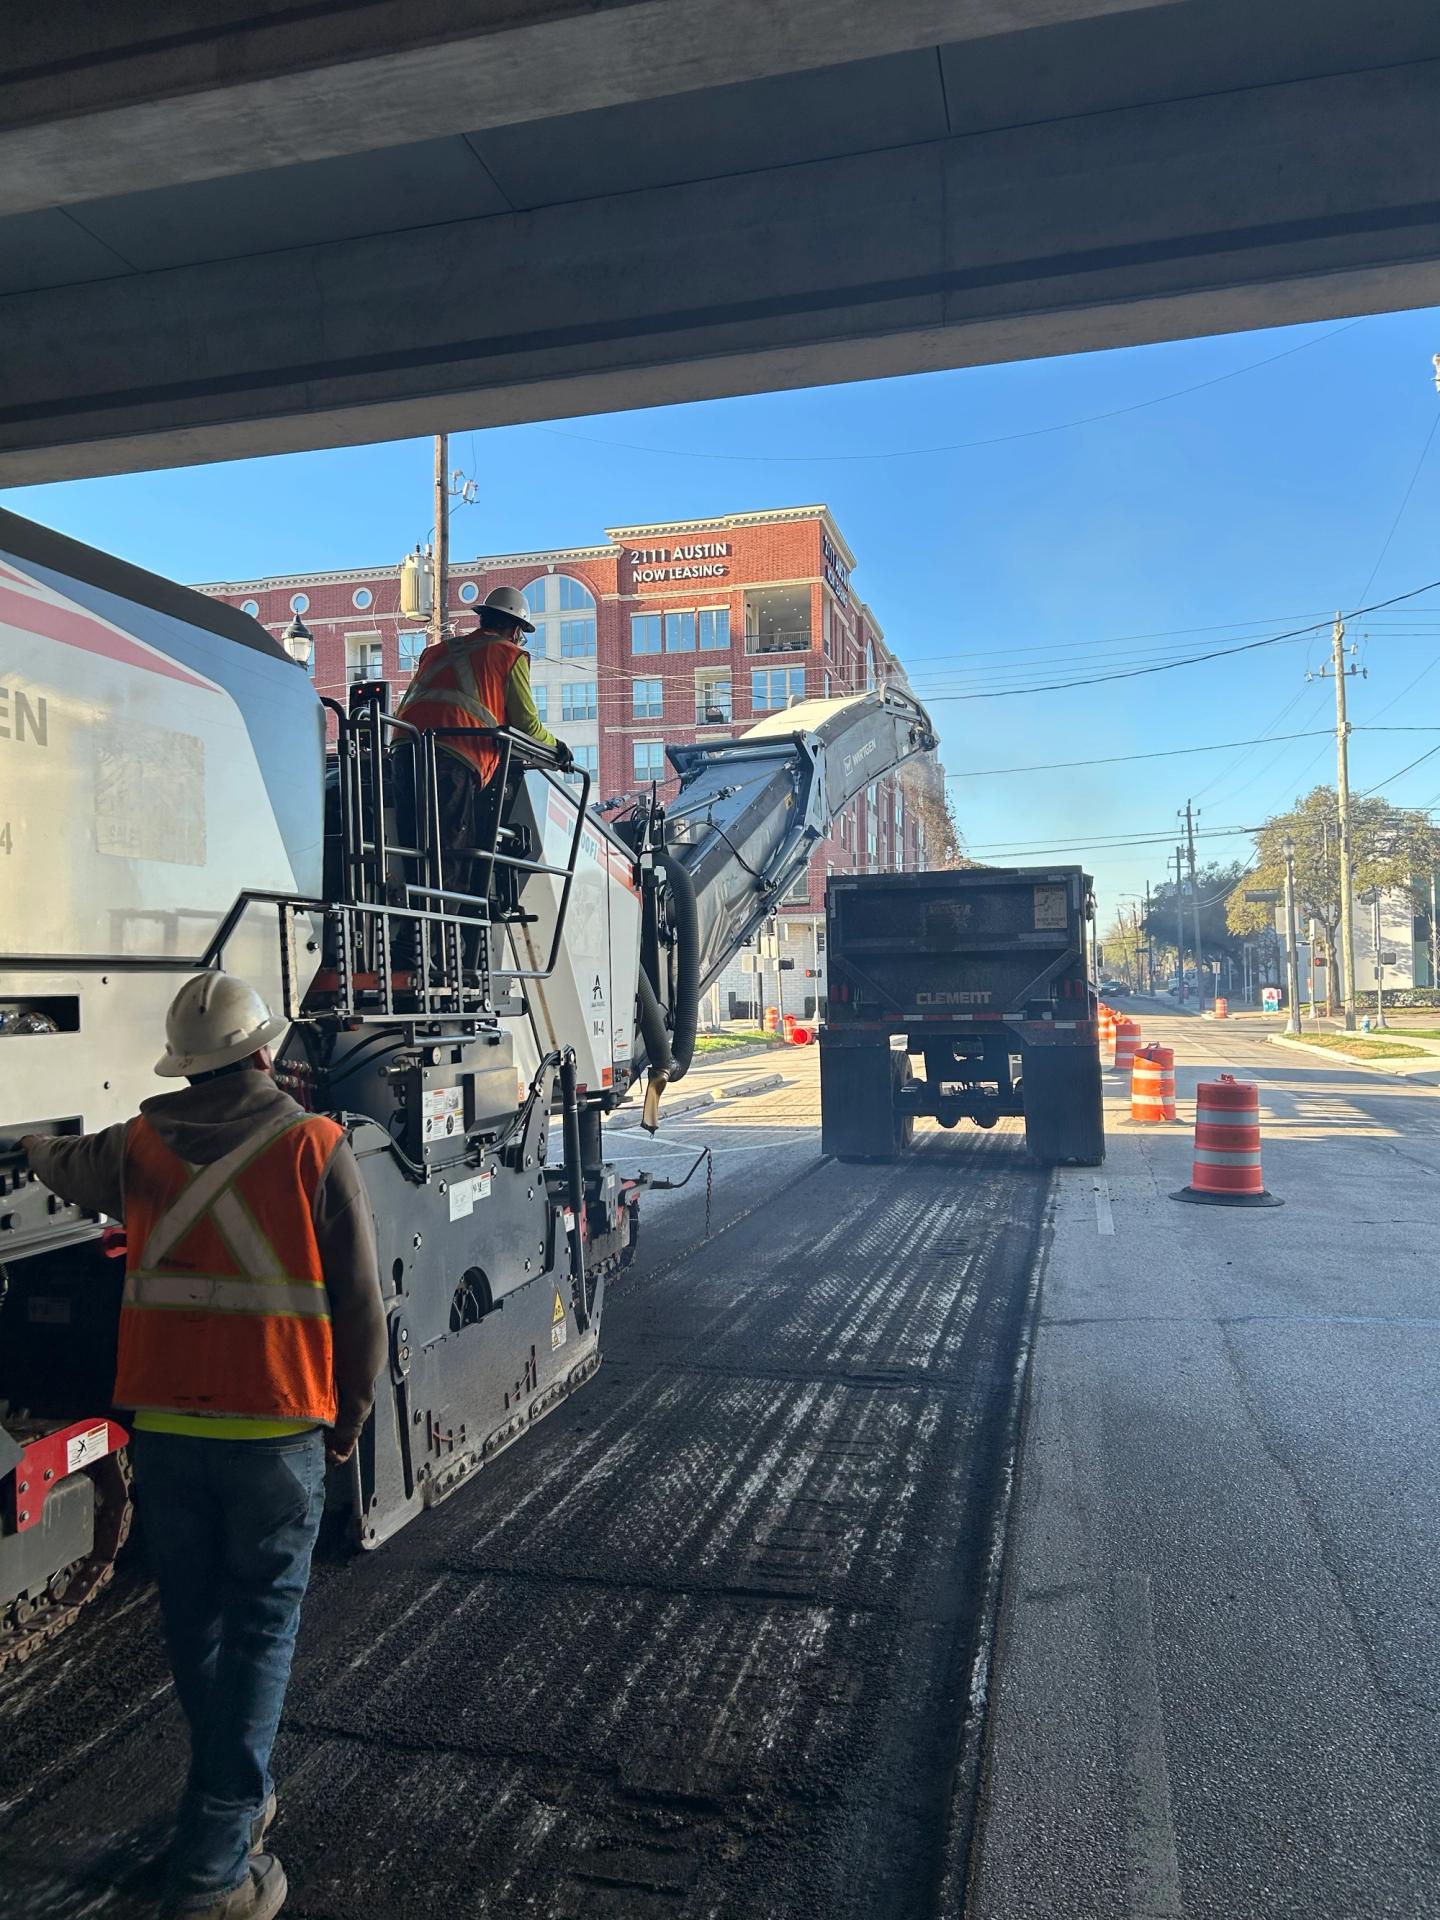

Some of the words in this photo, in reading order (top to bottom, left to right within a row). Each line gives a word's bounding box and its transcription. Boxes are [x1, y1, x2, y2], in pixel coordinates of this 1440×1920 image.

[630, 549, 666, 564] 2111
[673, 542, 727, 560] AUSTIN
[633, 569, 665, 583] NOW
[669, 563, 725, 579] LEASING
[916, 991, 992, 1005] CLEMENT
